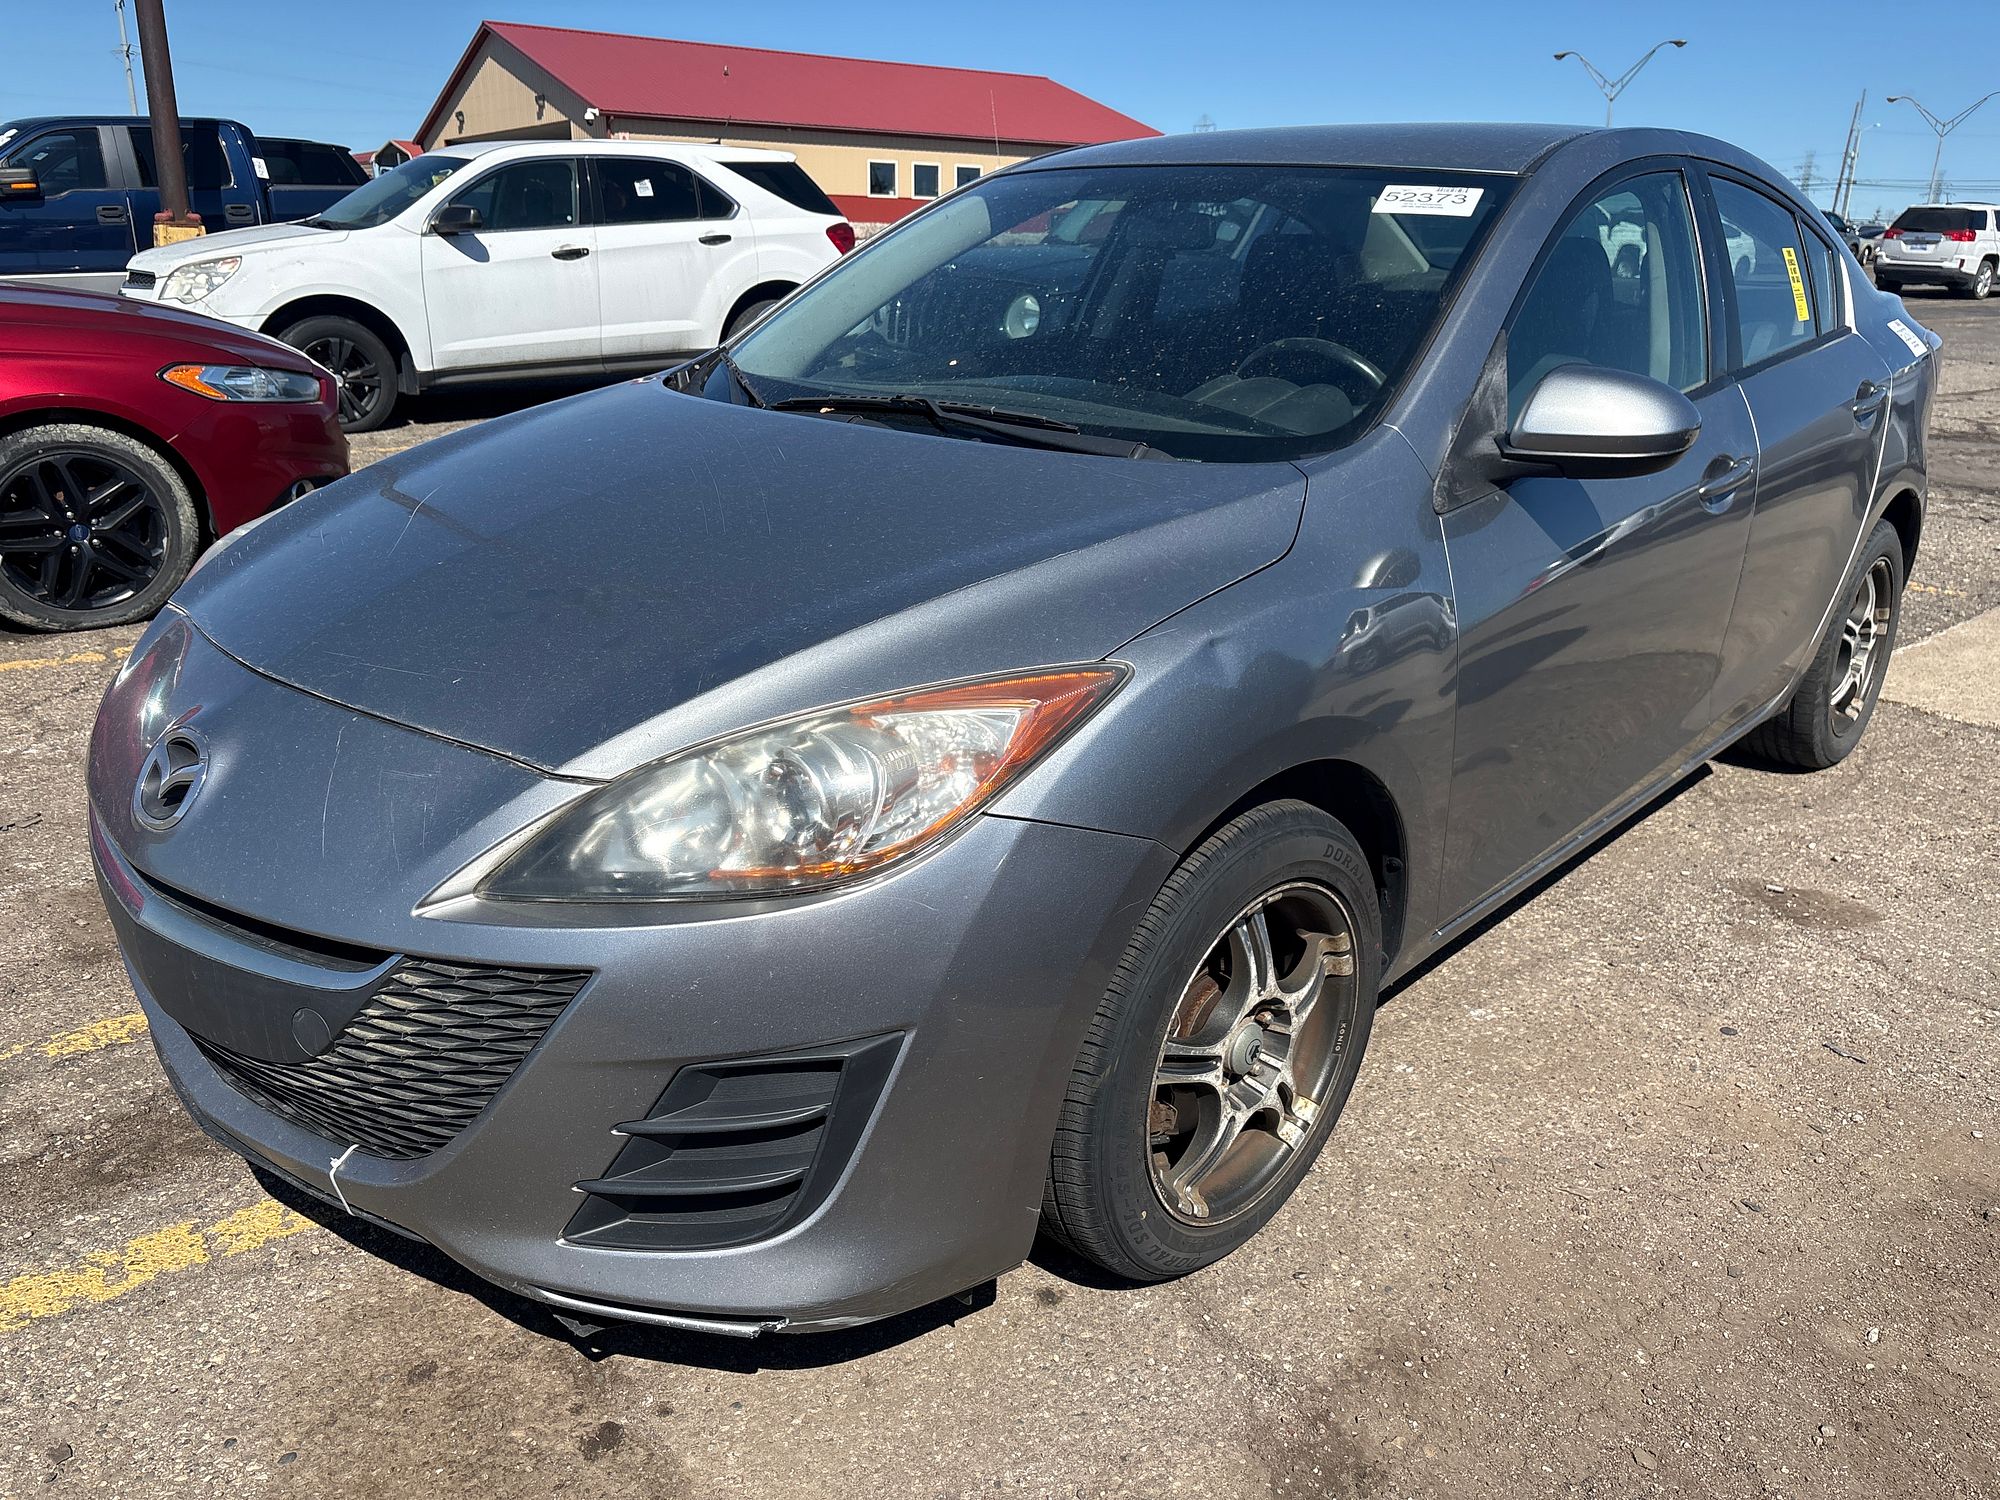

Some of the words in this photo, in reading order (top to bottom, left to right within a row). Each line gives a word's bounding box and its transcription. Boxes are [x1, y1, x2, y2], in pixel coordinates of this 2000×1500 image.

[1384, 192, 1468, 204] 52373
[1323, 843, 1365, 884] DORAL
[1146, 1244, 1203, 1269] DORAL
